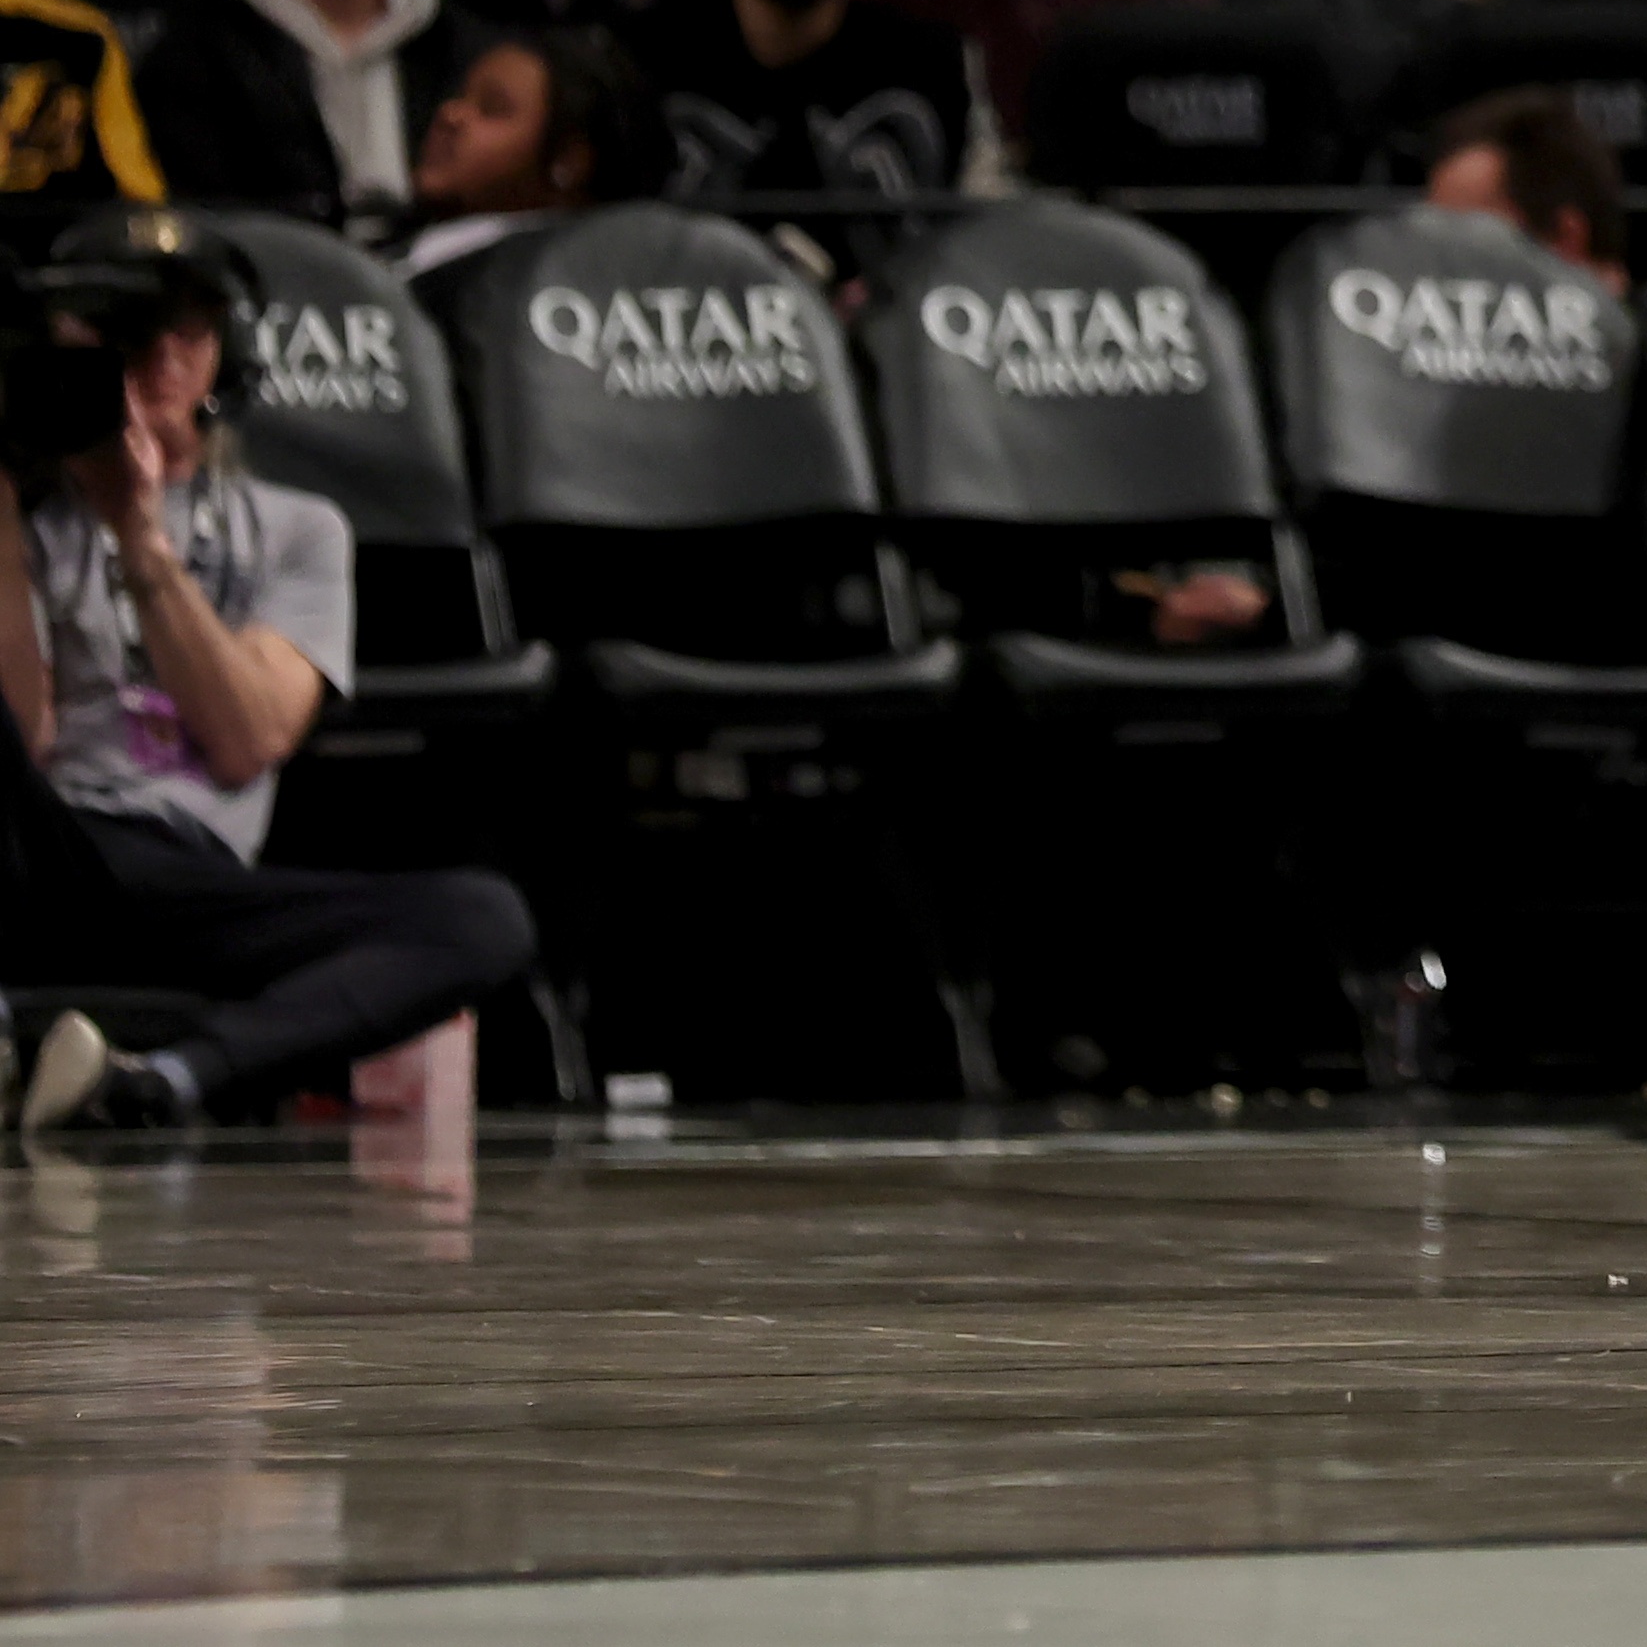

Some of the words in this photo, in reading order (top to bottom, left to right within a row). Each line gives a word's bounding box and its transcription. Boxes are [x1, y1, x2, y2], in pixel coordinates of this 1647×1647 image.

[256, 304, 397, 371] TAR
[529, 285, 801, 371] QATAR
[921, 285, 1193, 369] QATAR
[1329, 268, 1600, 353] QATAR
[604, 354, 815, 399] AIRWAYS
[996, 354, 1206, 396] AIRWAYS
